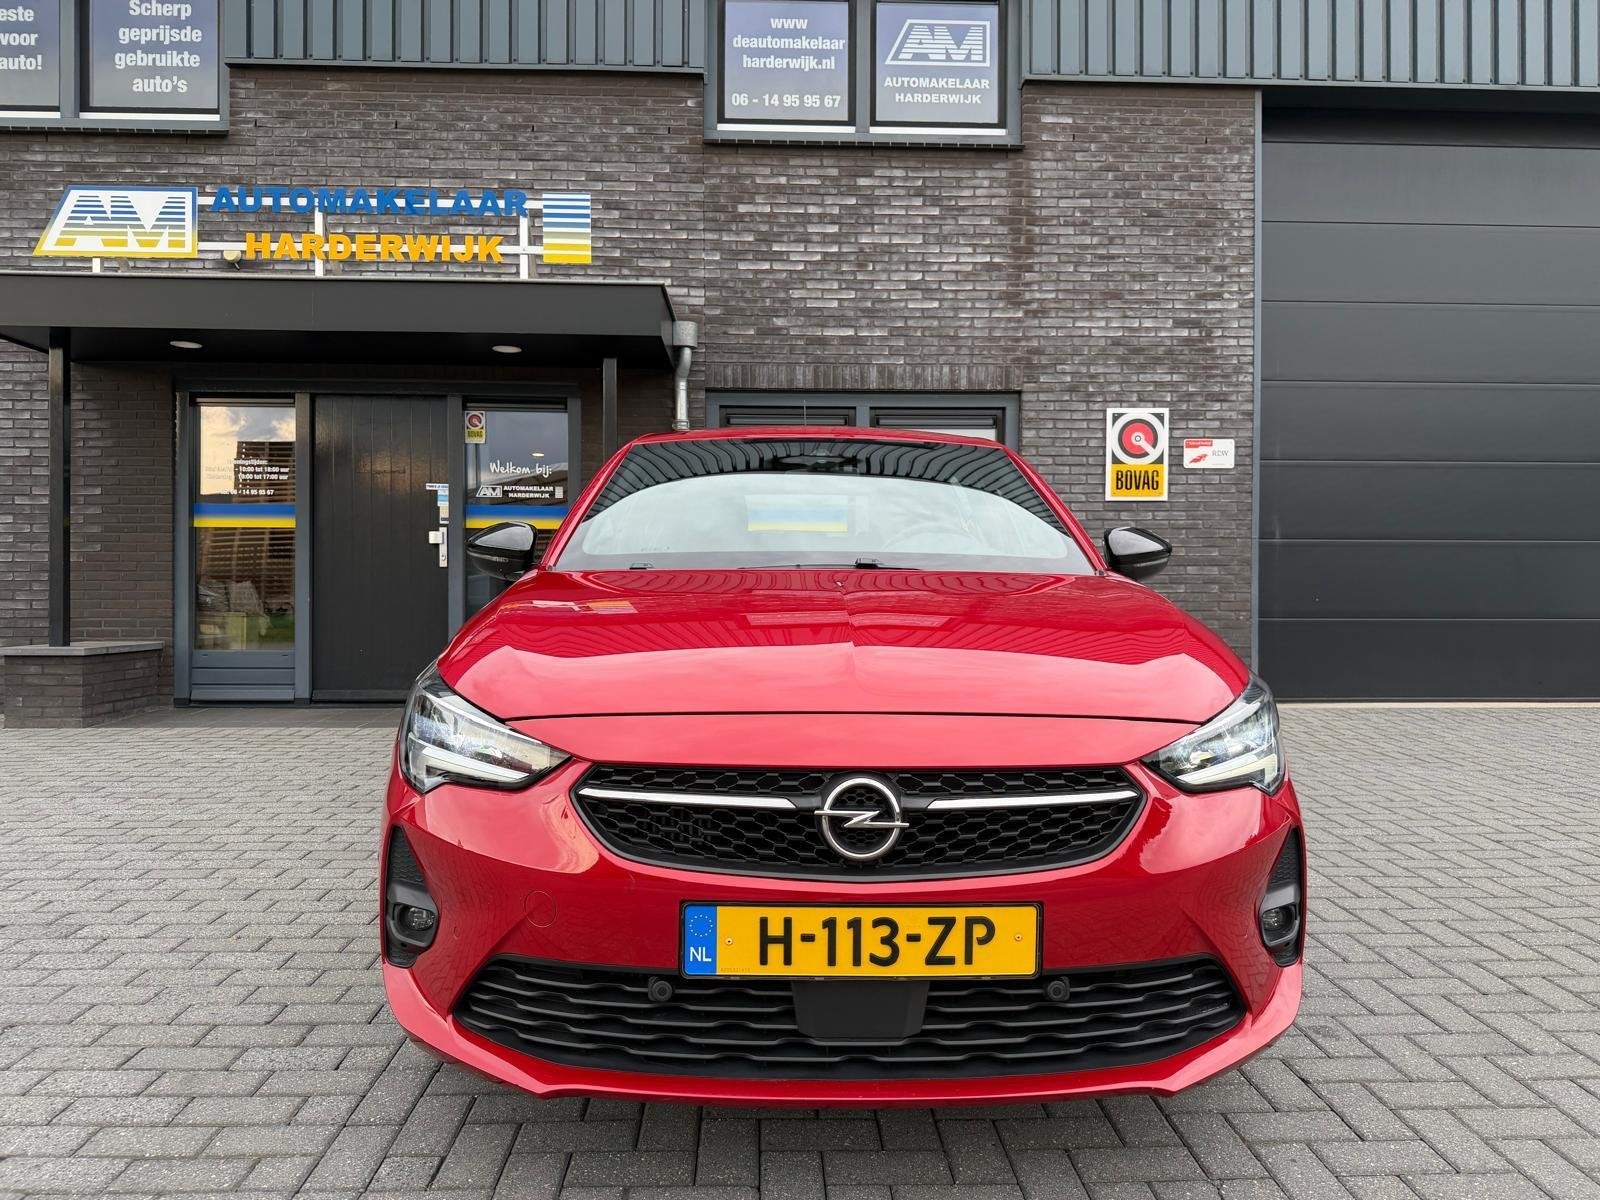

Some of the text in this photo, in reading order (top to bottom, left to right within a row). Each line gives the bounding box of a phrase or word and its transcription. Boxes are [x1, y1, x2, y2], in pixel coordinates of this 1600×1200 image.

[129, 0, 192, 20] Scherp
[771, 17, 808, 29] www
[0, 33, 39, 46] voor
[118, 25, 202, 44] geprijsde
[733, 35, 846, 50] deautomakelaar
[898, 25, 984, 61] AM
[0, 54, 42, 70] auto!
[114, 50, 200, 70] gebruikte
[742, 54, 836, 71] harderwijk.nl
[132, 75, 188, 93] auto's
[884, 77, 990, 89] AUTOMAKELAAR
[731, 93, 749, 106] 06
[763, 94, 779, 107] 14
[783, 94, 800, 107] 95
[803, 95, 820, 108] 95
[824, 95, 841, 108] 67
[895, 93, 982, 104] HARDERWIJK
[209, 186, 529, 217] AUTOMAKELAAR
[52, 193, 187, 249] AM
[246, 232, 504, 264] HARDERWIJK
[489, 460, 552, 478] Welkom bij:
[1115, 470, 1160, 490] BOVAG
[759, 915, 997, 967] H-113-ZP
[689, 946, 712, 962] NL
